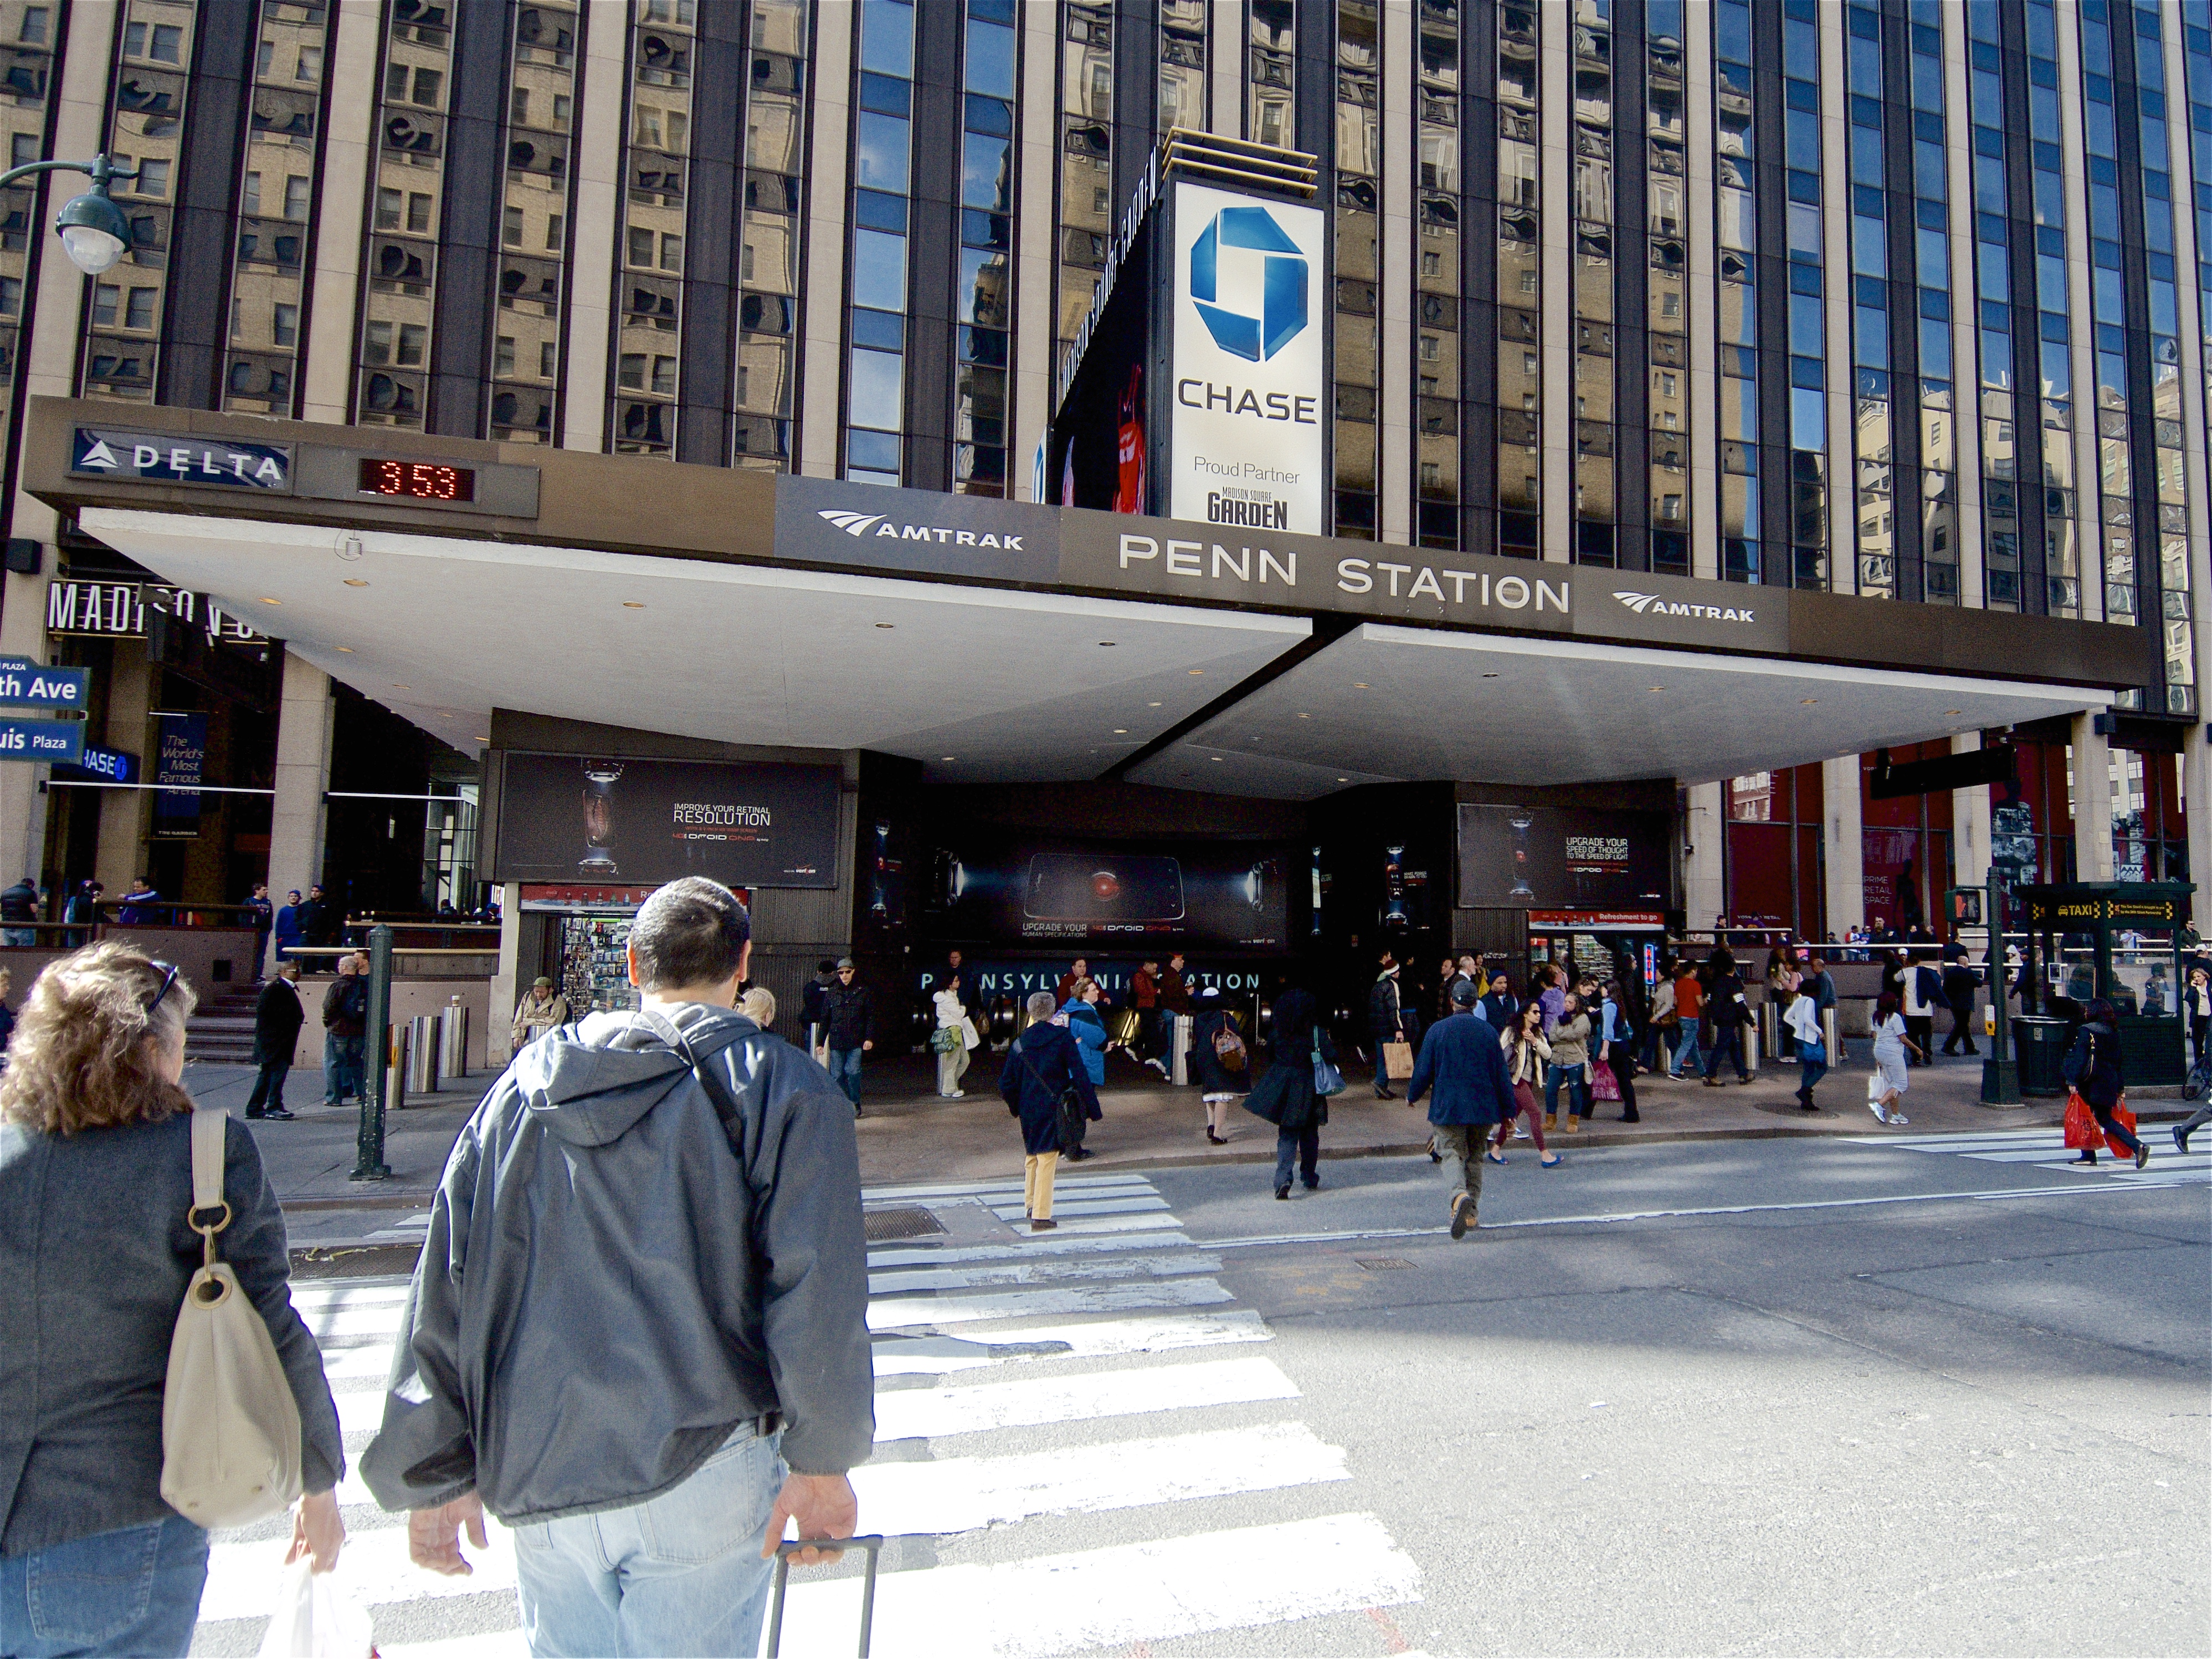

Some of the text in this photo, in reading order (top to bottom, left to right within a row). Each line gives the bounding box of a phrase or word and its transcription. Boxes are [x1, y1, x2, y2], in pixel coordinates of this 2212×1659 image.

[1178, 378, 1317, 424] CHASE
[133, 445, 281, 480] DELTA
[1194, 456, 1300, 484] Proud Partner
[1223, 487, 1271, 503] MADISON SQUARE
[1208, 491, 1287, 530] GARDEN
[876, 523, 1023, 551] AMTRAK
[1120, 534, 1569, 613] PENN STATION
[1652, 601, 1754, 622] AMTRAK
[28, 677, 77, 699] Ave
[33, 735, 66, 749] Plaza
[166, 735, 188, 746] The
[84, 749, 116, 775] HASE
[171, 759, 199, 771] Most
[159, 771, 201, 784] Famous
[674, 810, 770, 826] RESOLUTION
[1567, 837, 1604, 846] UPGRADE
[2069, 905, 2092, 916] TAXI
[1023, 923, 1087, 931] UPGRADE YOUR
